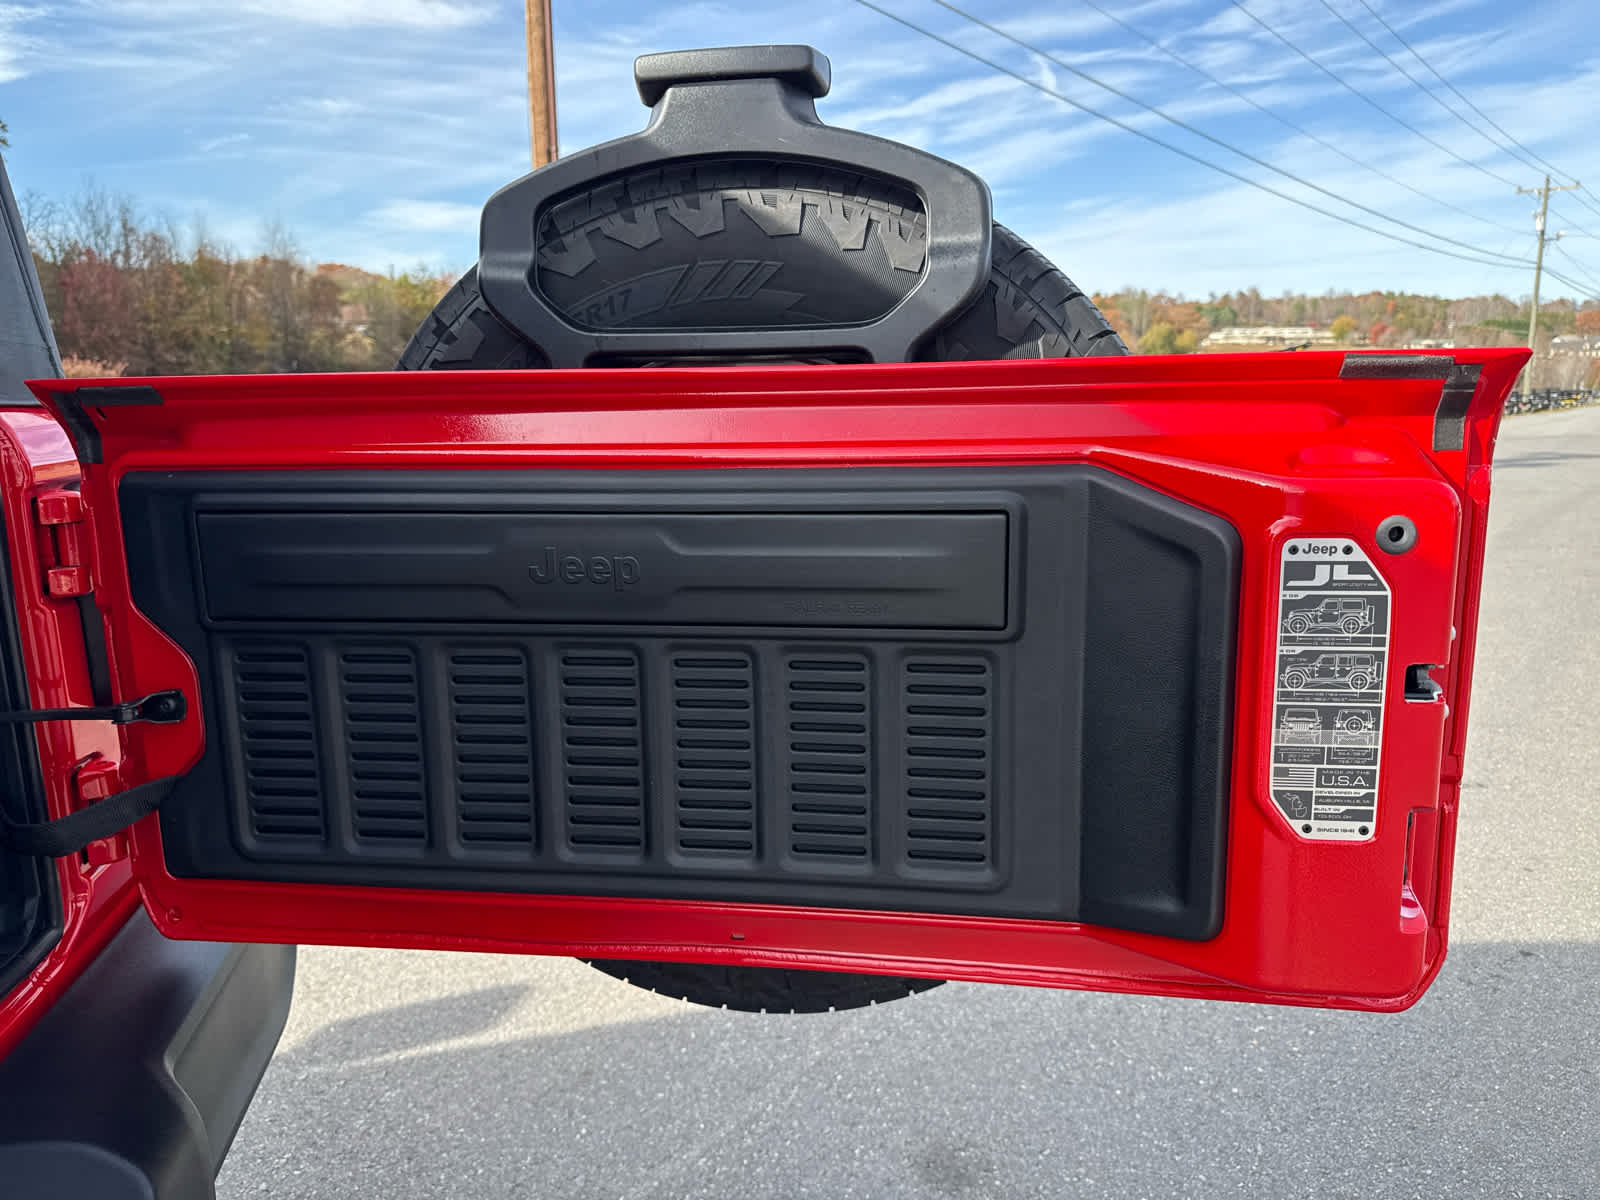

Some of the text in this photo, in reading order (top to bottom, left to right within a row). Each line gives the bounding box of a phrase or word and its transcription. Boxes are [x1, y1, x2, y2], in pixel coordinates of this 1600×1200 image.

[1302, 543, 1338, 556] Jeep
[528, 544, 642, 592] Jeep
[1286, 564, 1375, 587] JL
[1321, 775, 1370, 787] U.S.A.
